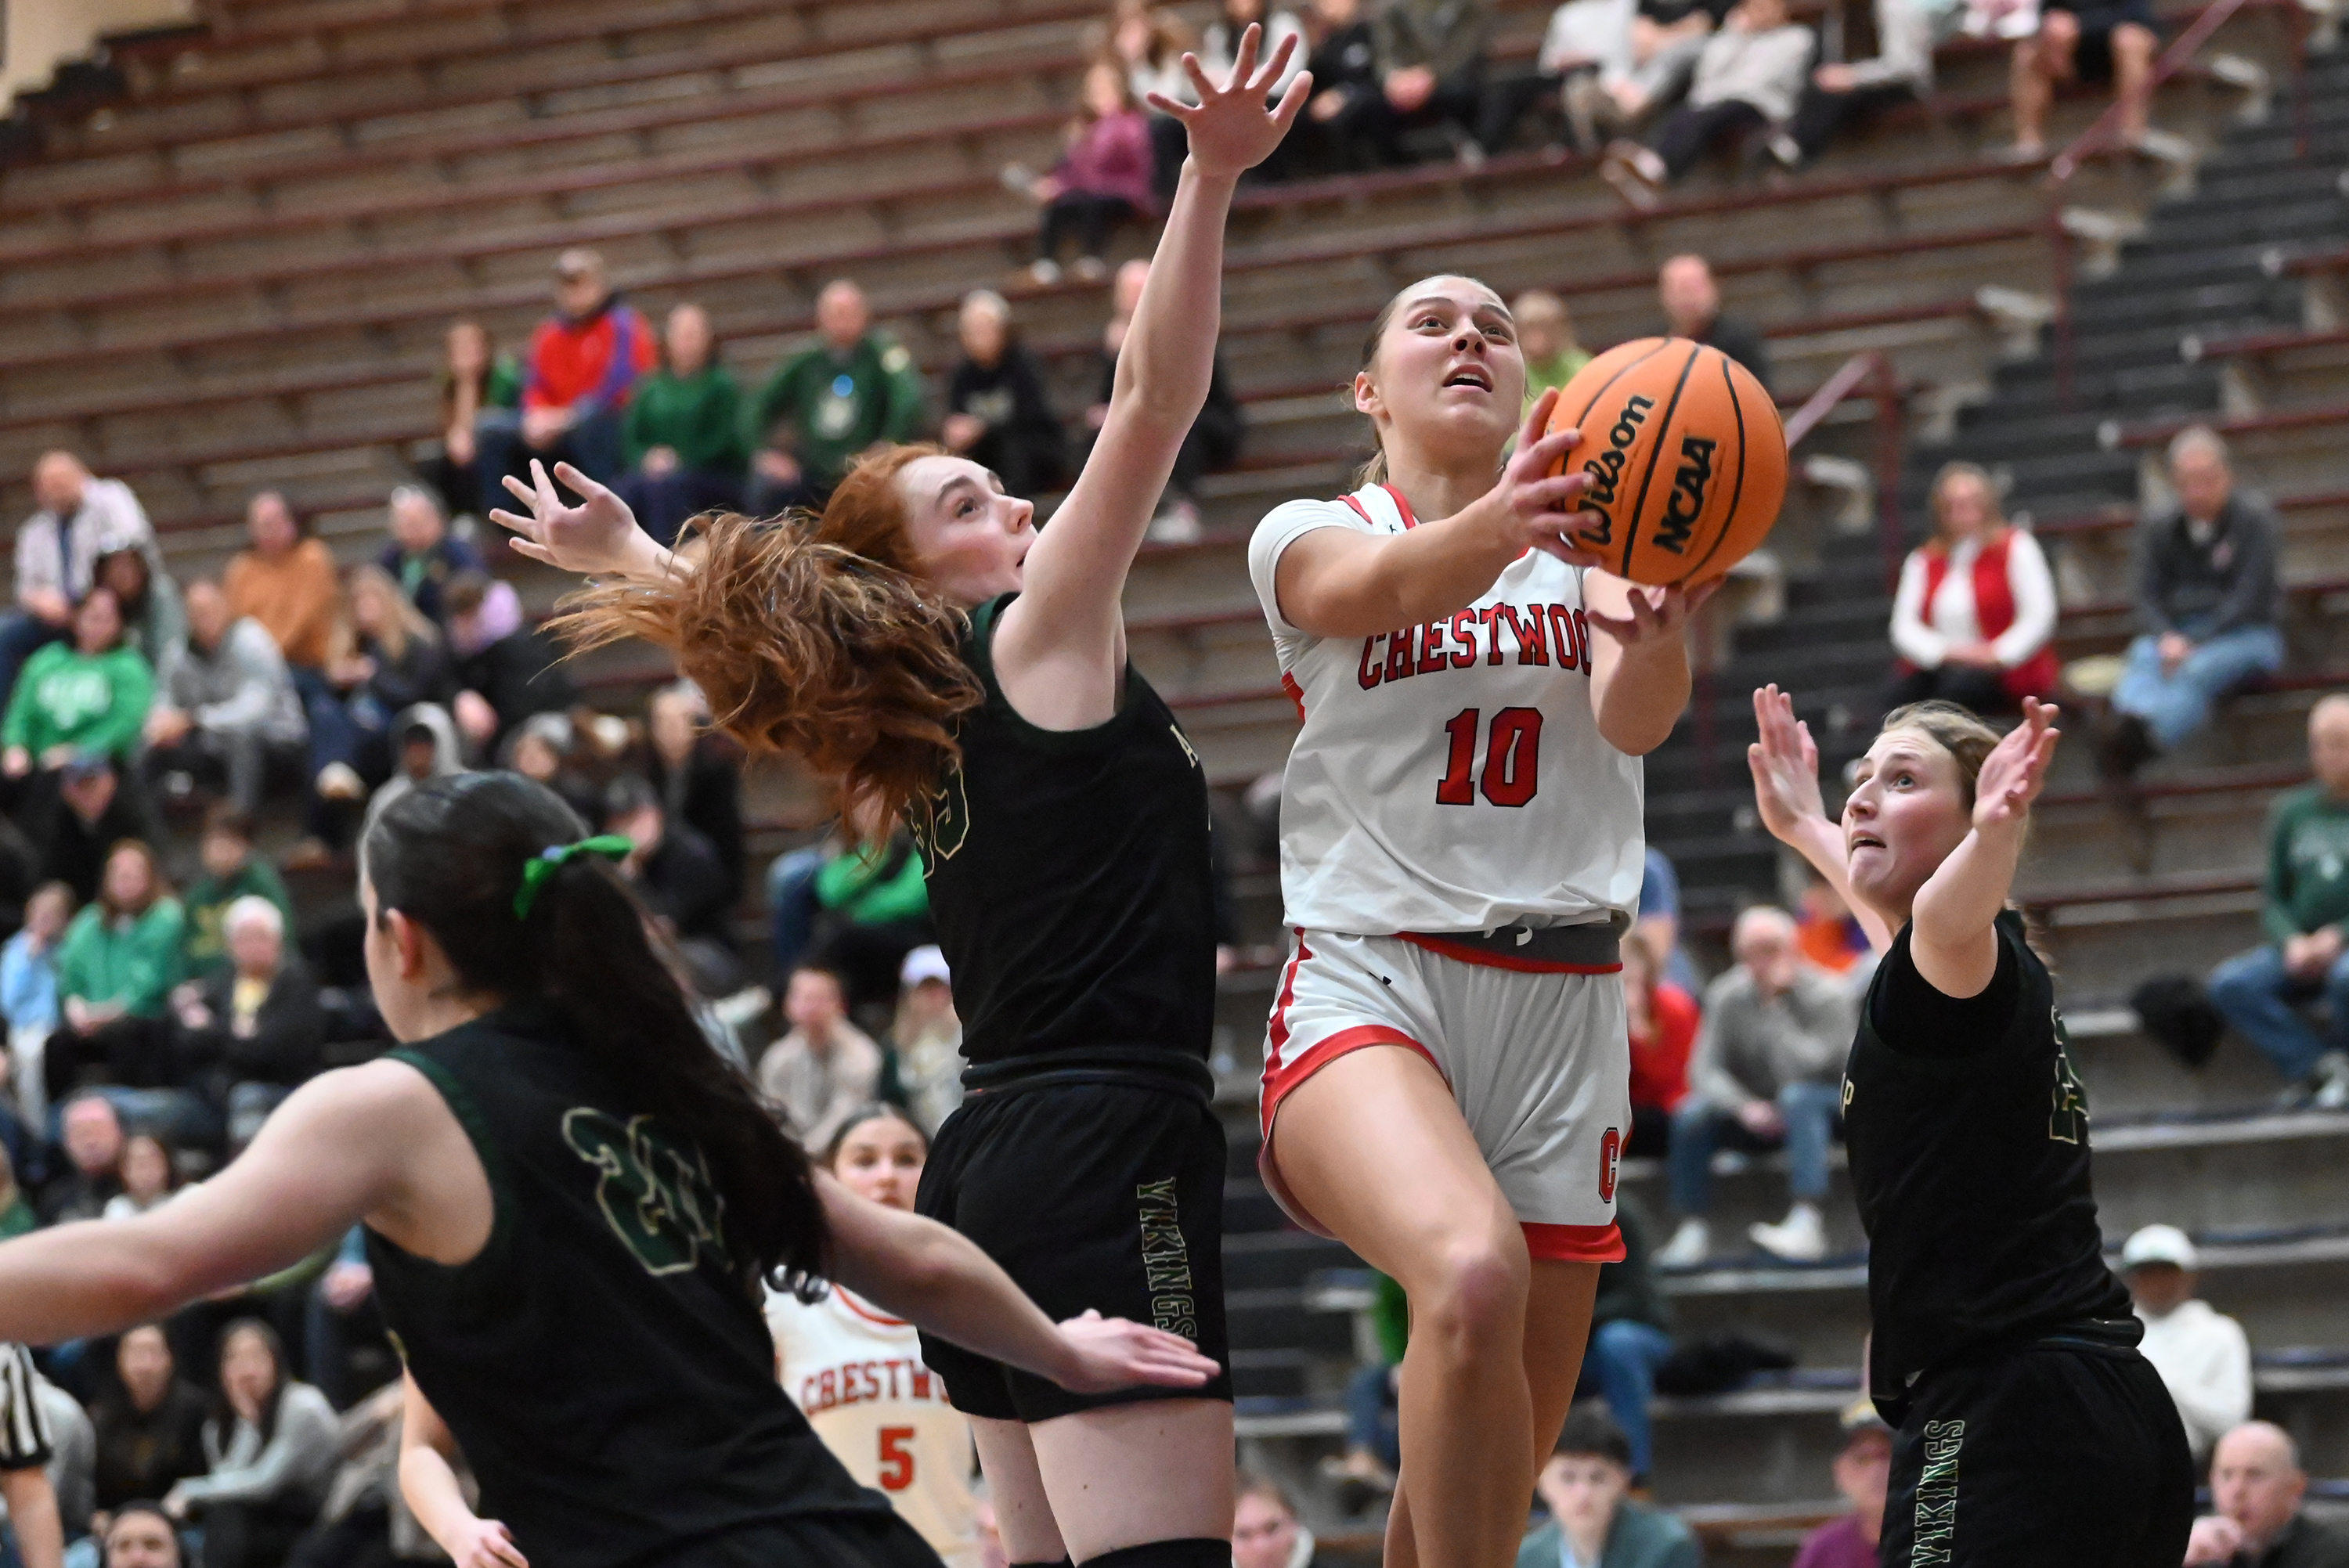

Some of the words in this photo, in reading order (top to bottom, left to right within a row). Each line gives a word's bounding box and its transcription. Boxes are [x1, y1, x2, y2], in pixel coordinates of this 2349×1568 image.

[1651, 438, 1716, 555] NCAA
[1436, 706, 1544, 808] 10
[1598, 1127, 1620, 1204] C
[1137, 1176, 1197, 1338] VIKINGS
[879, 1426, 915, 1491] 5
[1911, 1419, 1965, 1568] VIKINGS
